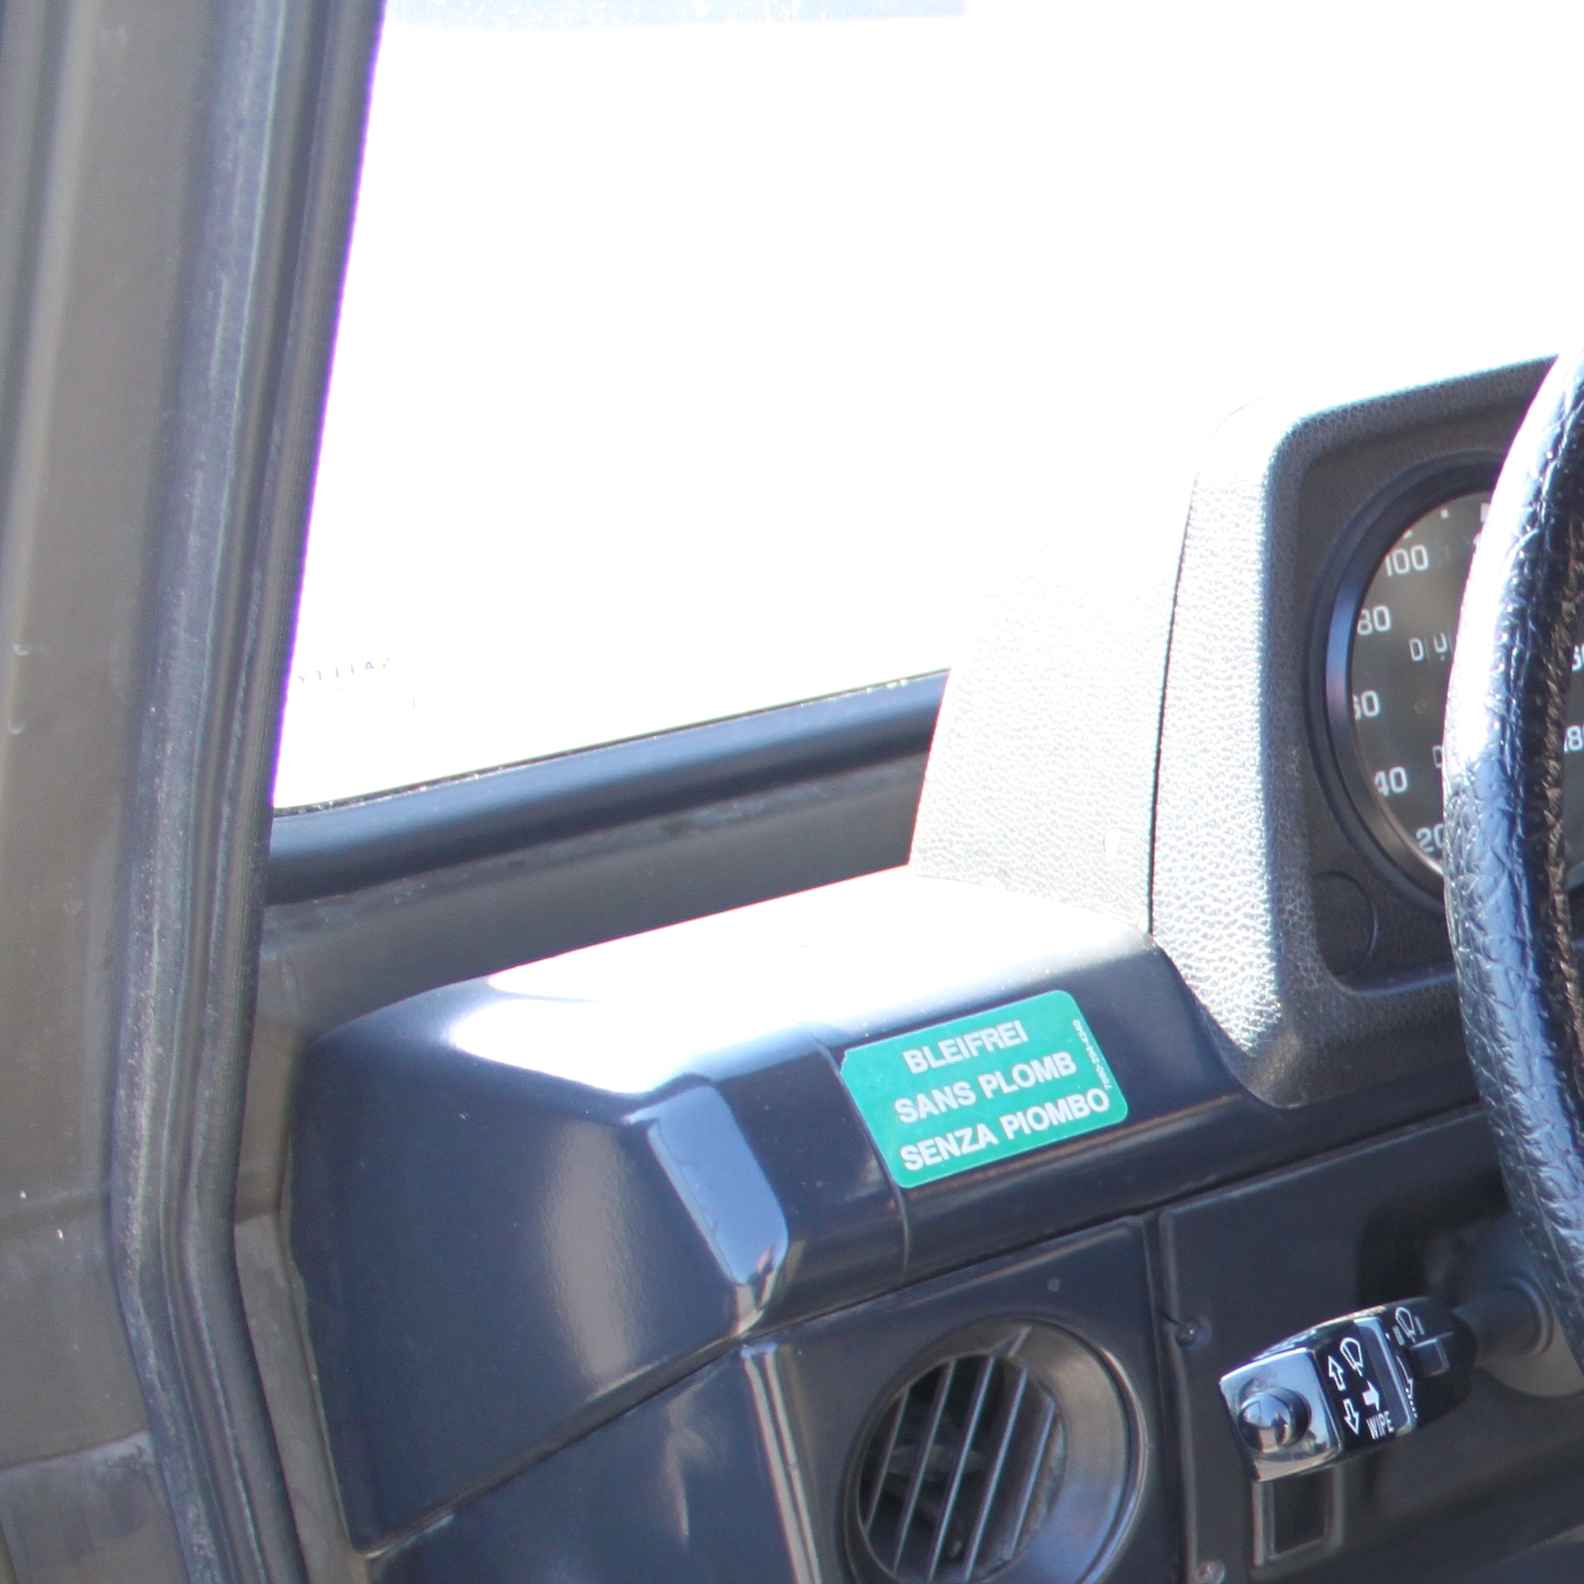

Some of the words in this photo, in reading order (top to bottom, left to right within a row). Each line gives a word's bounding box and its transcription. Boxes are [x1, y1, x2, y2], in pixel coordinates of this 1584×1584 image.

[1385, 544, 1428, 577] 100
[1357, 605, 1391, 635] 80
[1375, 766, 1408, 796] 40
[902, 1019, 1029, 1074] BLEIFREI
[895, 1080, 977, 1124] SANS
[977, 1051, 1078, 1099] PLOMB
[900, 1122, 999, 1171] SENZA
[999, 1087, 1111, 1140] PIOMBO
[1366, 1410, 1394, 1440] WIPE
